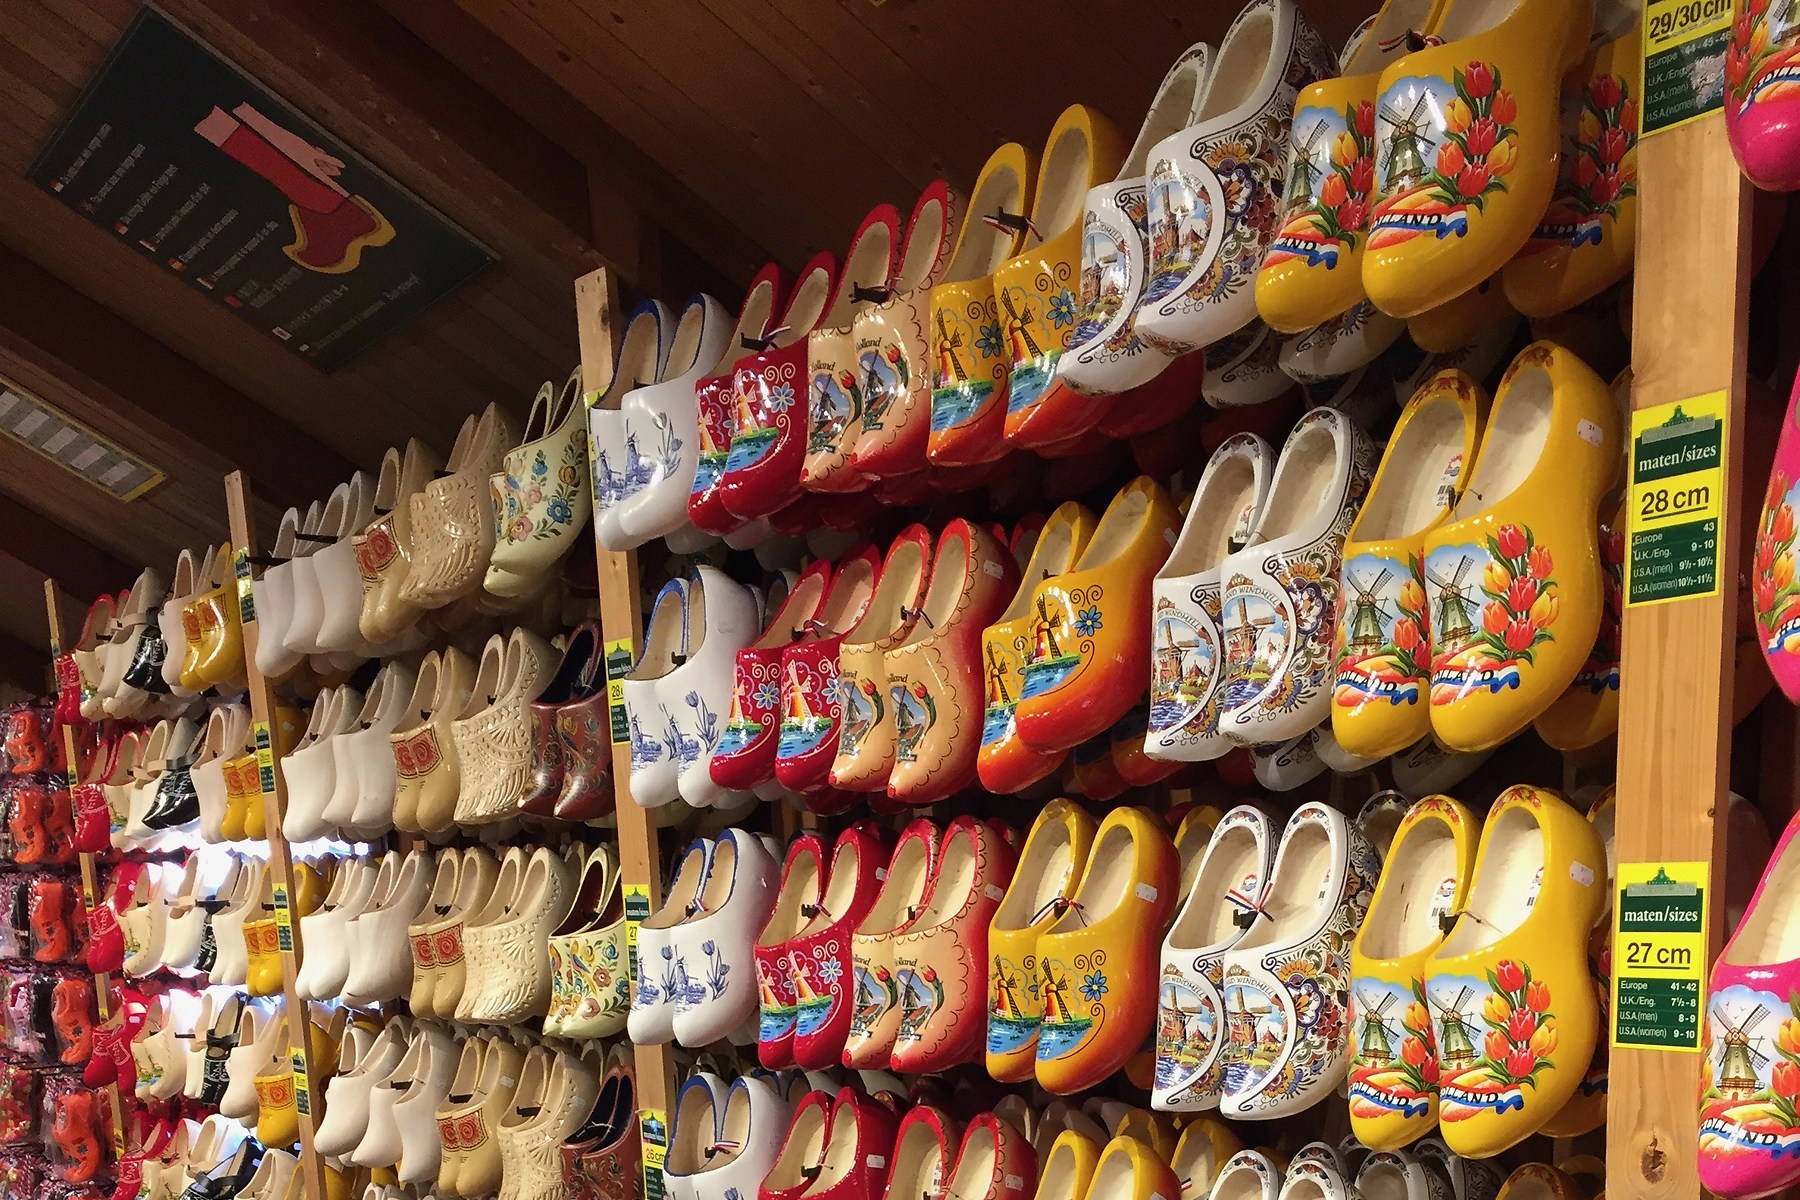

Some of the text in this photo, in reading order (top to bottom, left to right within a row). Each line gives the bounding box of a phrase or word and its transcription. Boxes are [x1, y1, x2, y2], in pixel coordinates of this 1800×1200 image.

[1650, 1, 1701, 39] 29/30
[1648, 52, 1678, 69] Europe
[1638, 444, 1717, 472] maten/sizes
[1641, 486, 1709, 516] 28 cm
[1635, 521, 1715, 547] Europe 43
[1240, 586, 1279, 606] WINDMILL
[1624, 905, 1699, 923] maten/sizes
[1627, 942, 1691, 964] 27 cm
[1171, 977, 1205, 997] WINDMILL
[1236, 977, 1272, 997] WINDMILL
[1621, 981, 1648, 992] Europe
